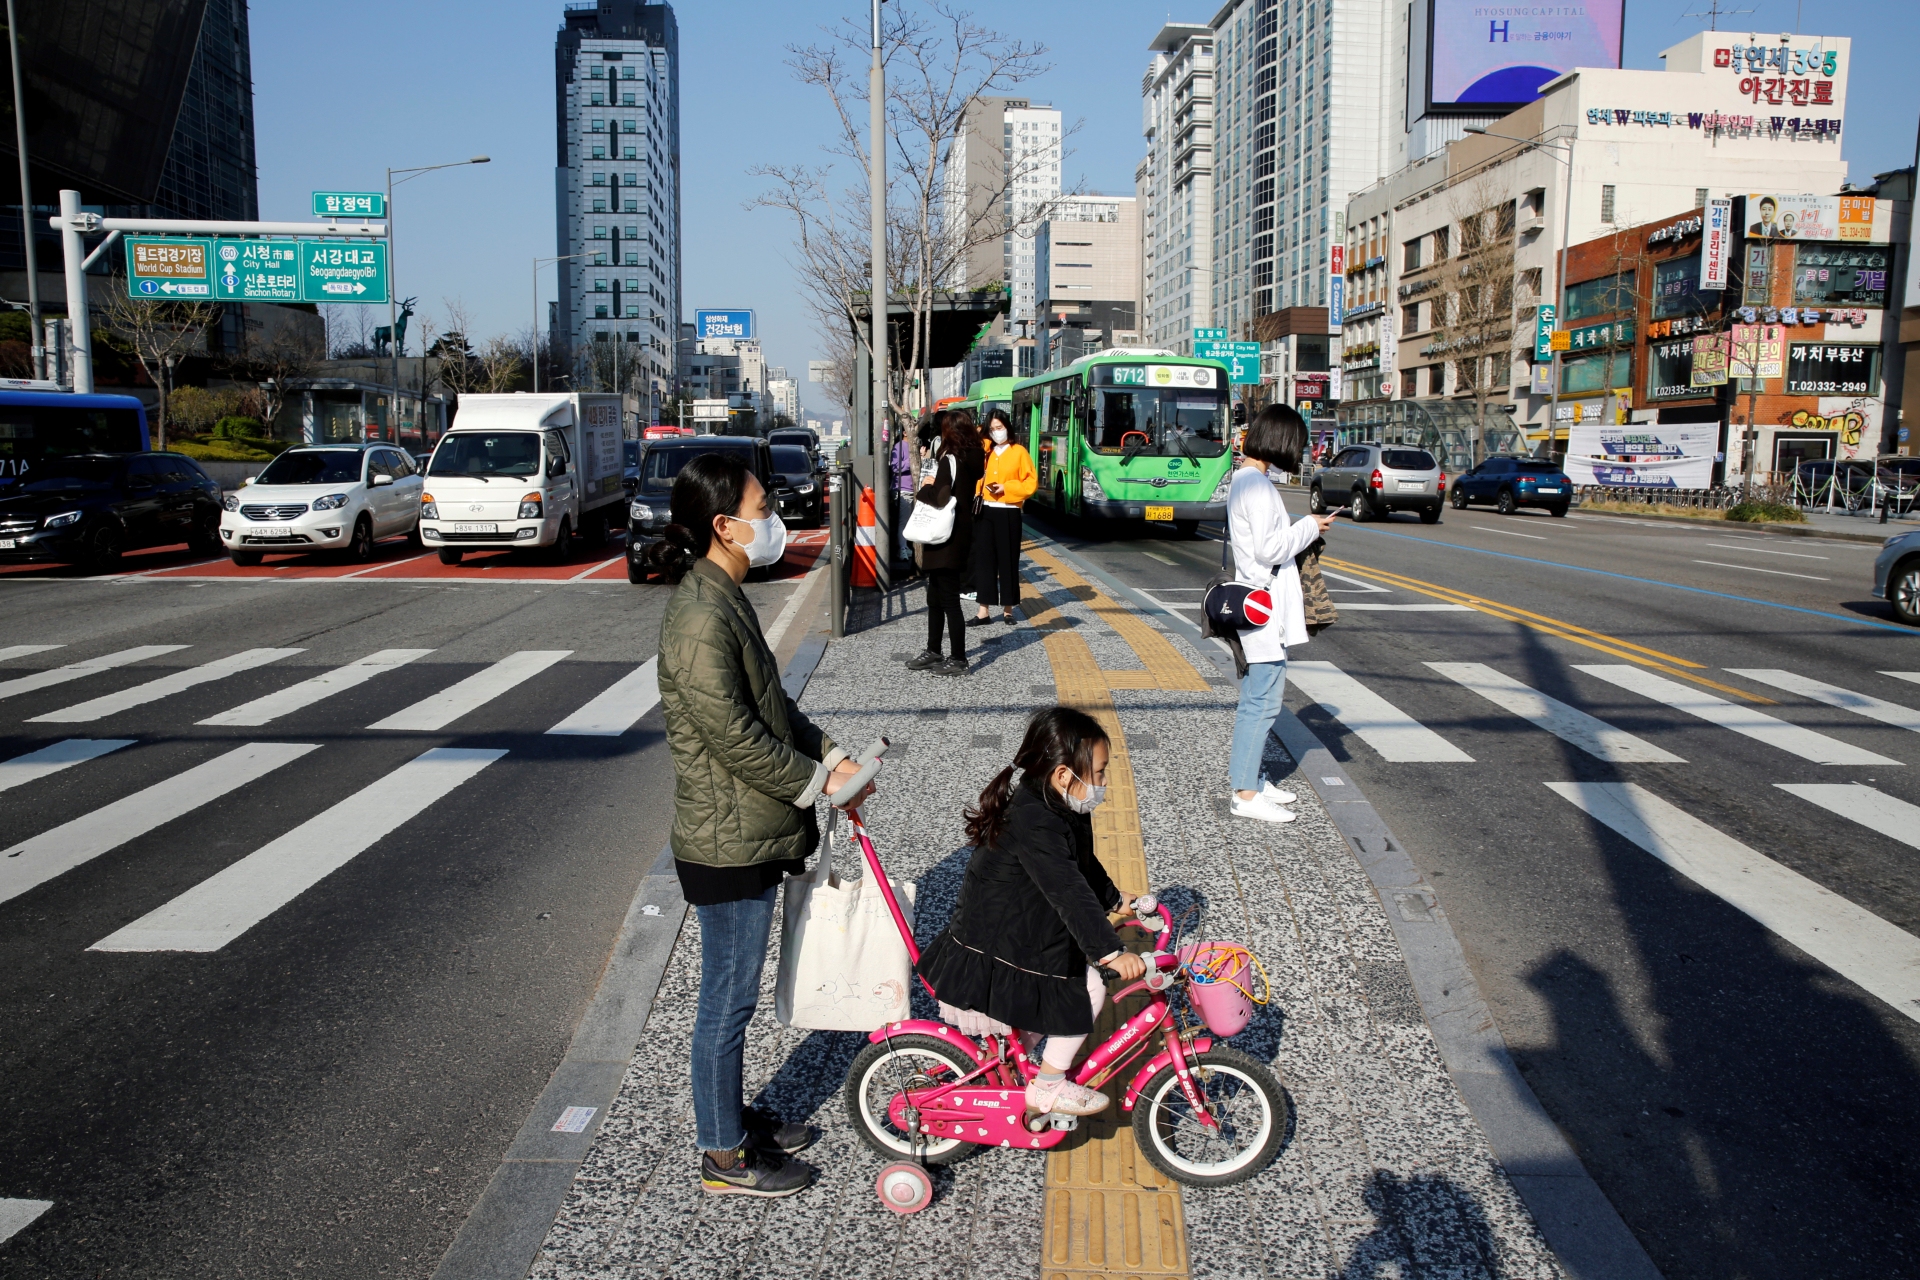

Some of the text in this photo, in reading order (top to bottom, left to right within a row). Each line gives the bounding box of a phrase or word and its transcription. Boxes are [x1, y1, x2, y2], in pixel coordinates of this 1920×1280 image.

[1474, 7, 1585, 16] HYOSUNG CAPITAL
[1745, 46, 1790, 75] 연세
[1793, 42, 1838, 77] 365
[1739, 76, 1834, 105] 야간진료
[325, 196, 371, 212] 합정역
[1711, 207, 1723, 228] 가발
[136, 246, 202, 263] 월드컵경기장
[223, 248, 235, 258] 60
[243, 245, 270, 259] 시청
[312, 249, 376, 265] 서강대교
[1708, 230, 1720, 280] 클리닉센터
[137, 263, 203, 274] World Cup Stadium
[243, 260, 280, 270] City Hall
[310, 265, 377, 280] Seogangdaegyo(Br)
[1751, 250, 1766, 286] 가발
[226, 276, 234, 285] 6
[244, 273, 296, 289] 신촌로터리
[1805, 268, 1829, 282] 맞춤
[144, 281, 152, 292] 1
[244, 288, 296, 299] Sinchon Rotary
[705, 323, 743, 336] 건강보험
[1791, 346, 1864, 363] 까치 부동산
[1114, 367, 1145, 383] 6712
[1790, 380, 1867, 392] T.02)332-2949
[1152, 511, 1172, 520] 1688
[1107, 1025, 1140, 1055] HIGH KICK
